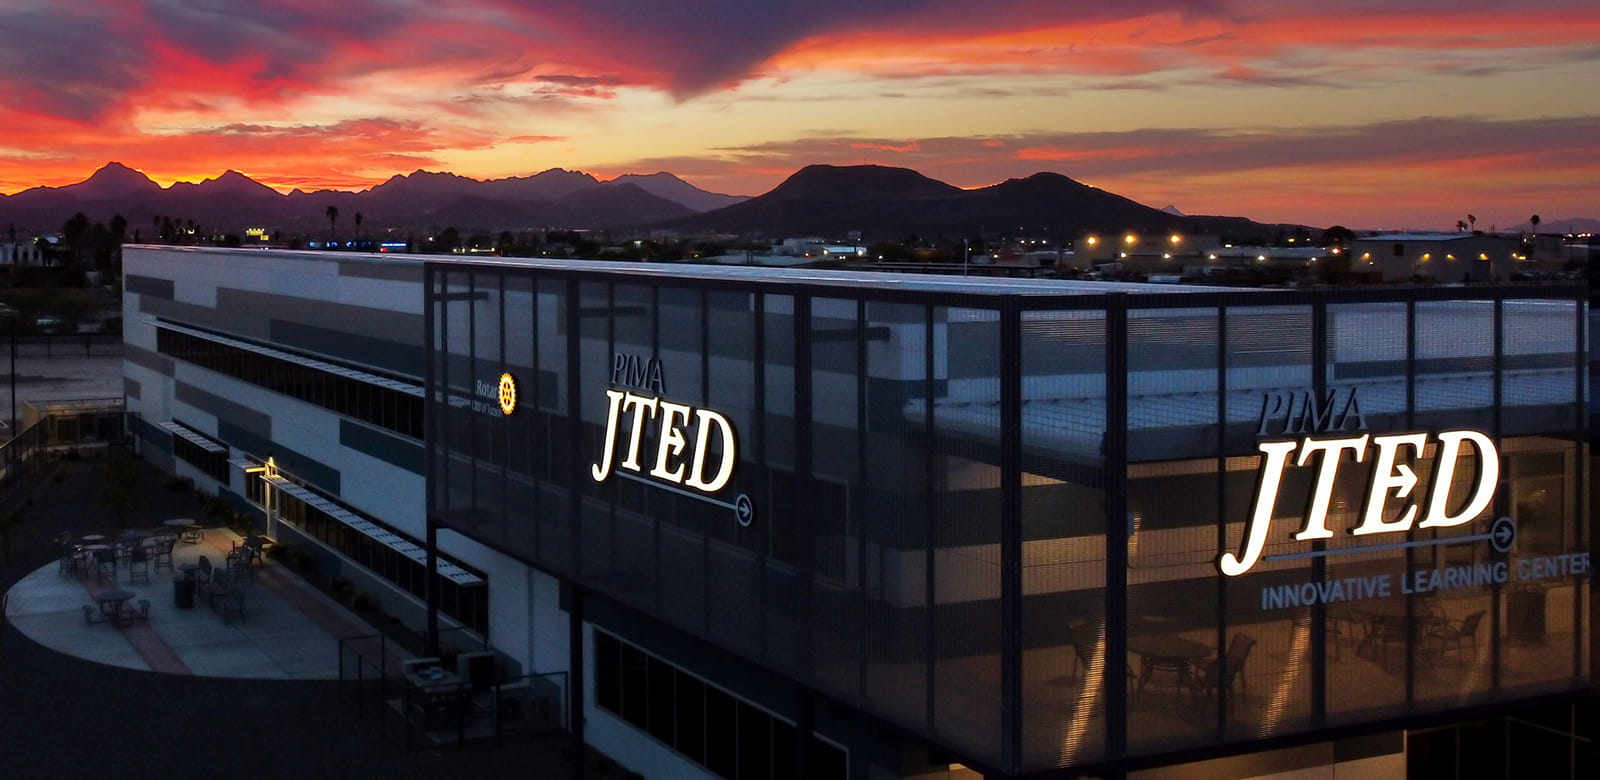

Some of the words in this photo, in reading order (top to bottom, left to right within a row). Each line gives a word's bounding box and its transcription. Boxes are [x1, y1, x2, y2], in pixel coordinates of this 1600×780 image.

[475, 379, 498, 399] Rotar
[611, 352, 666, 394] PIMA
[1256, 387, 1369, 436] PIMA
[591, 389, 736, 492] JTED
[1219, 430, 1501, 577] JTED
[1261, 574, 1392, 611] INNOVATIVE
[1400, 562, 1509, 595] LEARNING
[1518, 552, 1590, 580] CENTER
